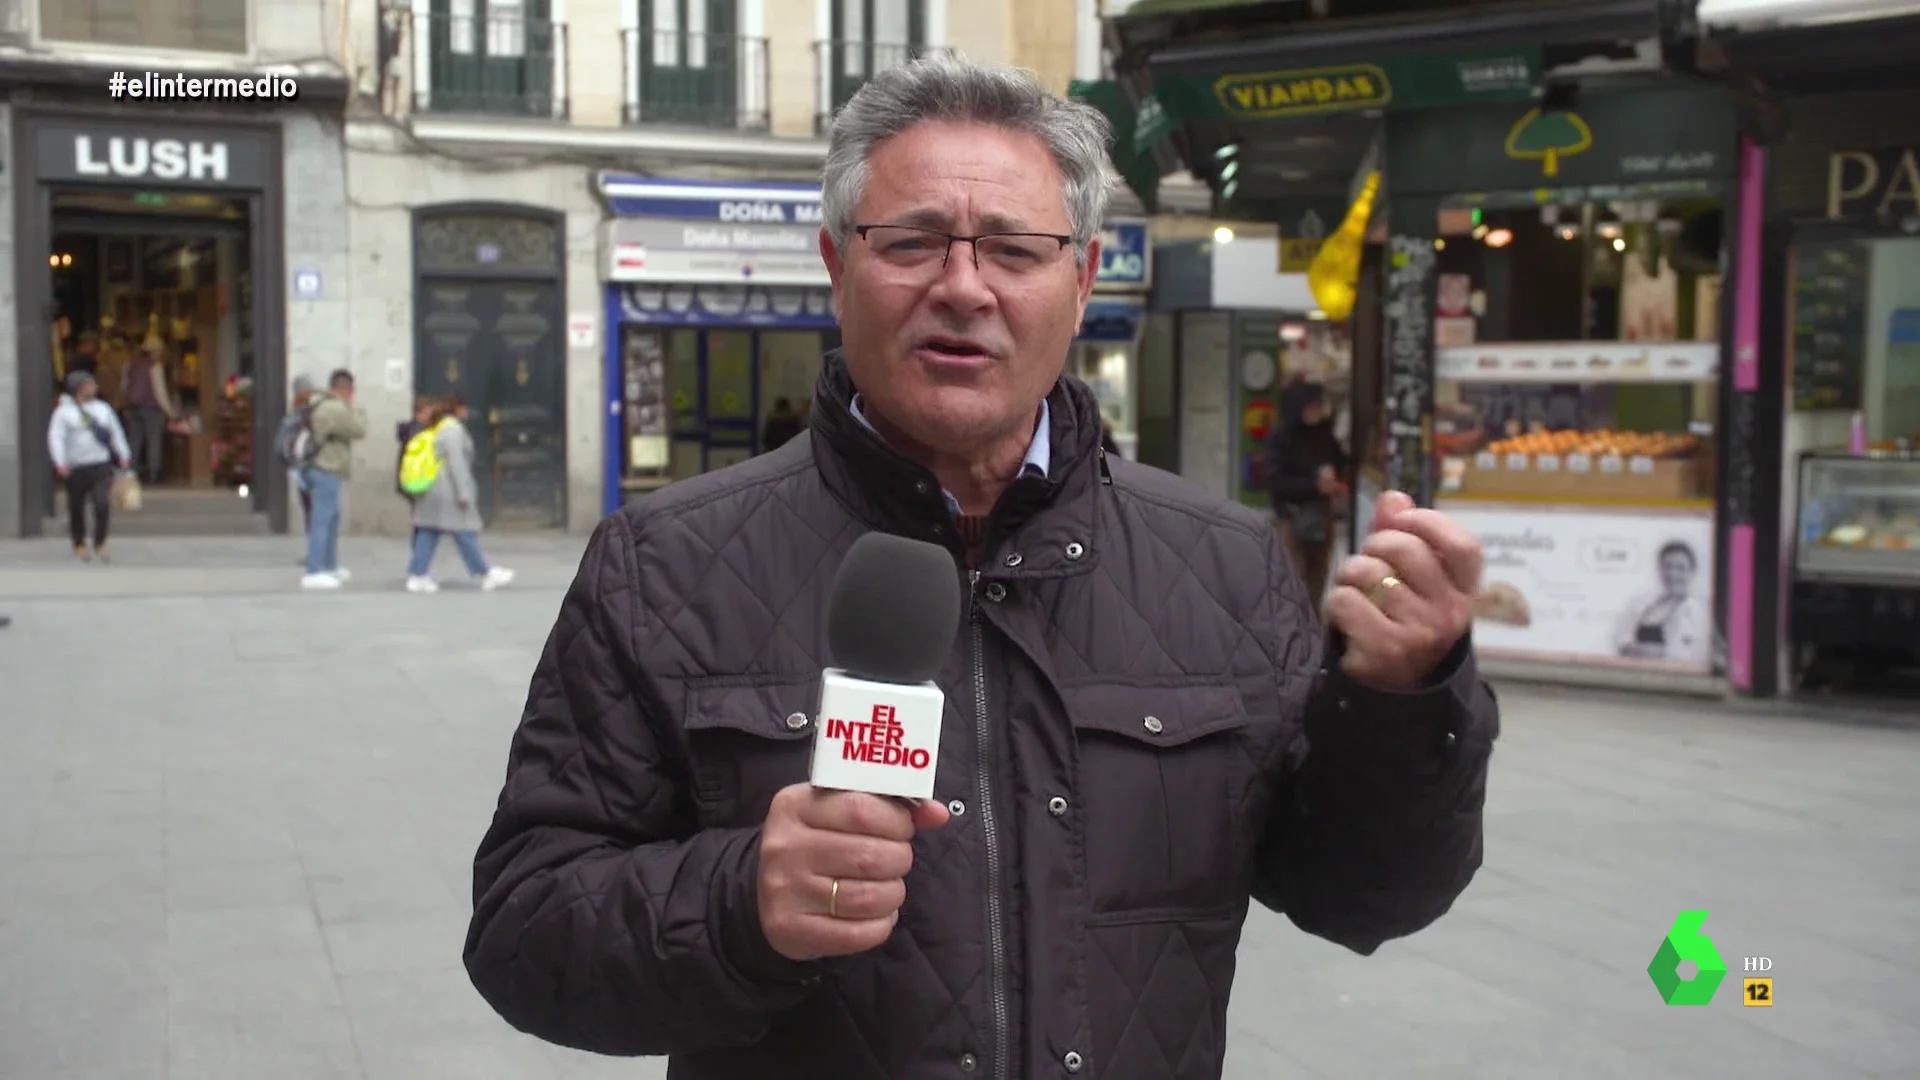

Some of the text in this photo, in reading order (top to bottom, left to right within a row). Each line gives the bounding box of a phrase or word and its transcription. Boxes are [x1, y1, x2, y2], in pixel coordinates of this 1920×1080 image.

[1231, 74, 1374, 109] VIANDAS
[74, 134, 229, 181] LUSH
[1827, 149, 1920, 219] PA
[719, 200, 786, 222] DOÑA
[871, 703, 902, 726] EL
[825, 718, 905, 747] INTER
[841, 740, 931, 770] MEDIO
